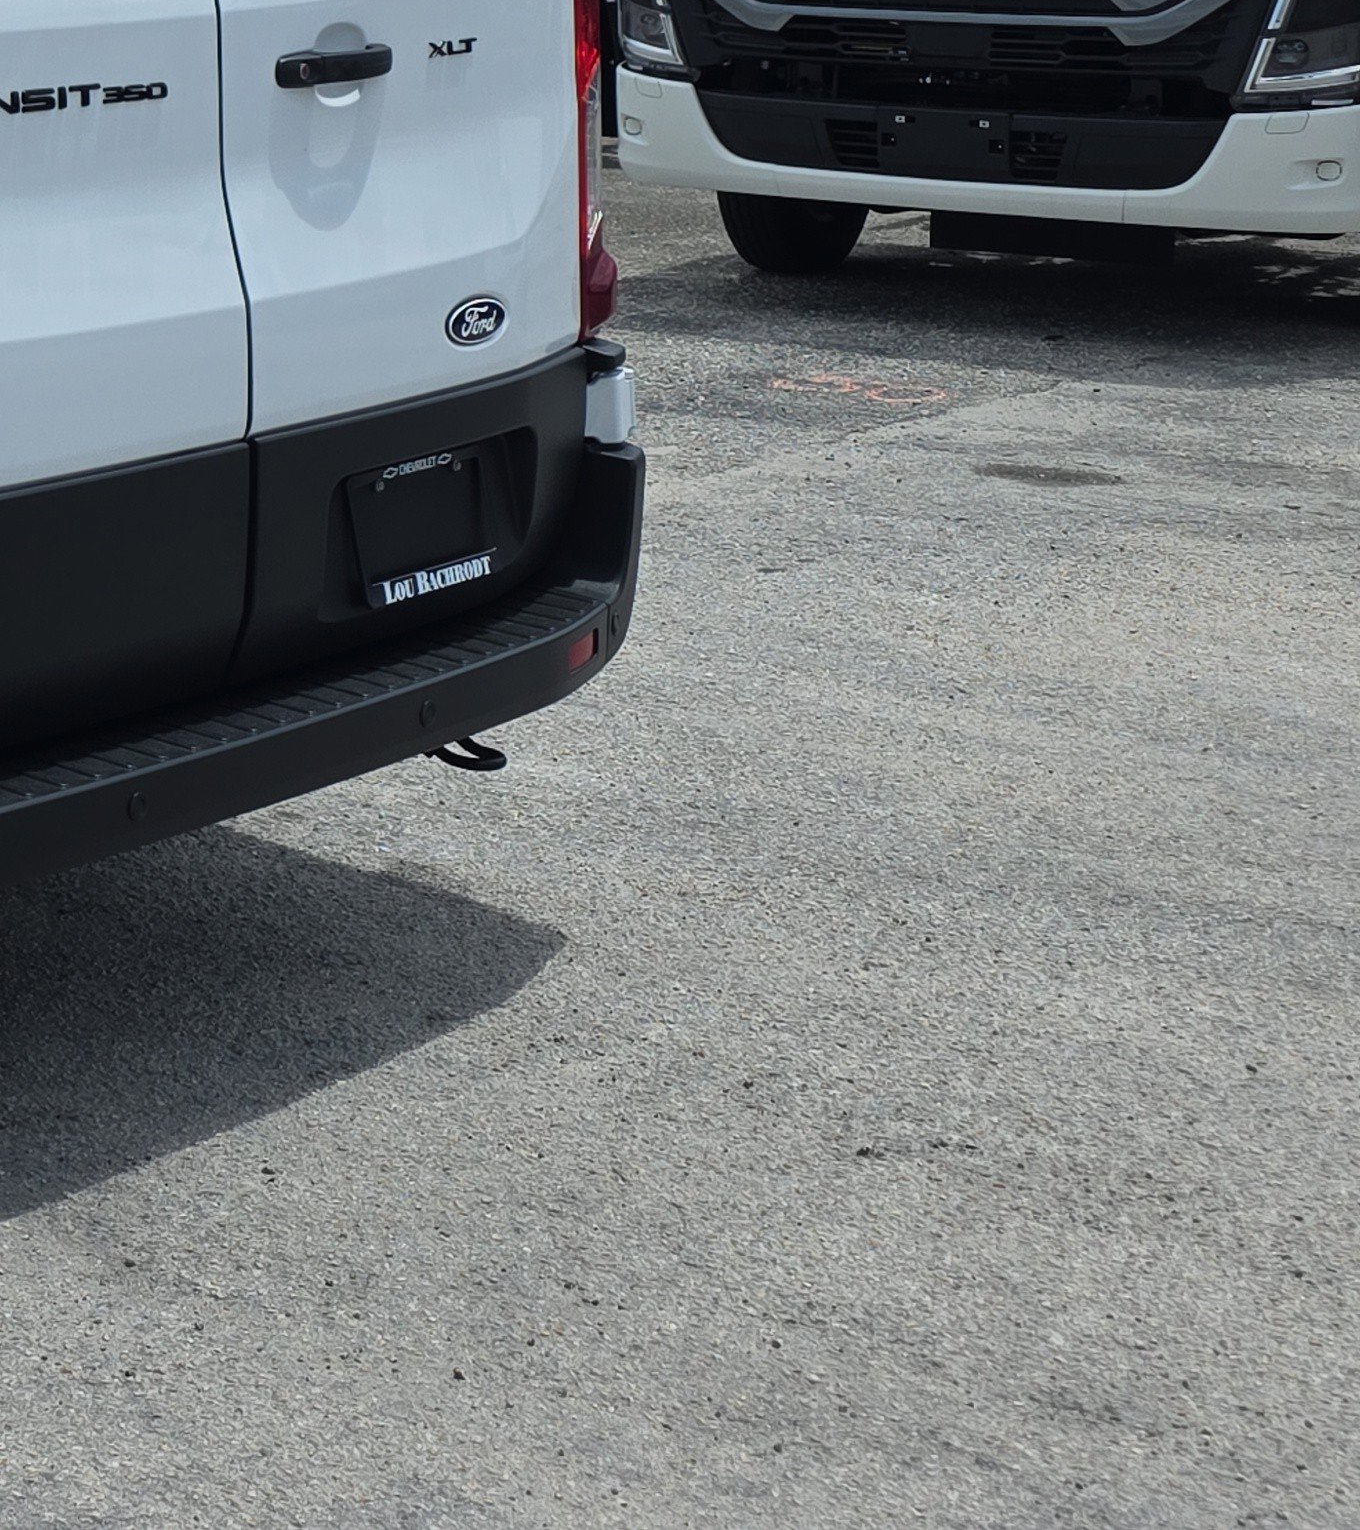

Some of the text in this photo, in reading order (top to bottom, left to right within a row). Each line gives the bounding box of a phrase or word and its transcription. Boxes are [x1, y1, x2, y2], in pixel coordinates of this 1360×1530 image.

[428, 37, 478, 59] XLT
[461, 305, 497, 338] Ford
[382, 578, 415, 605] LOU
